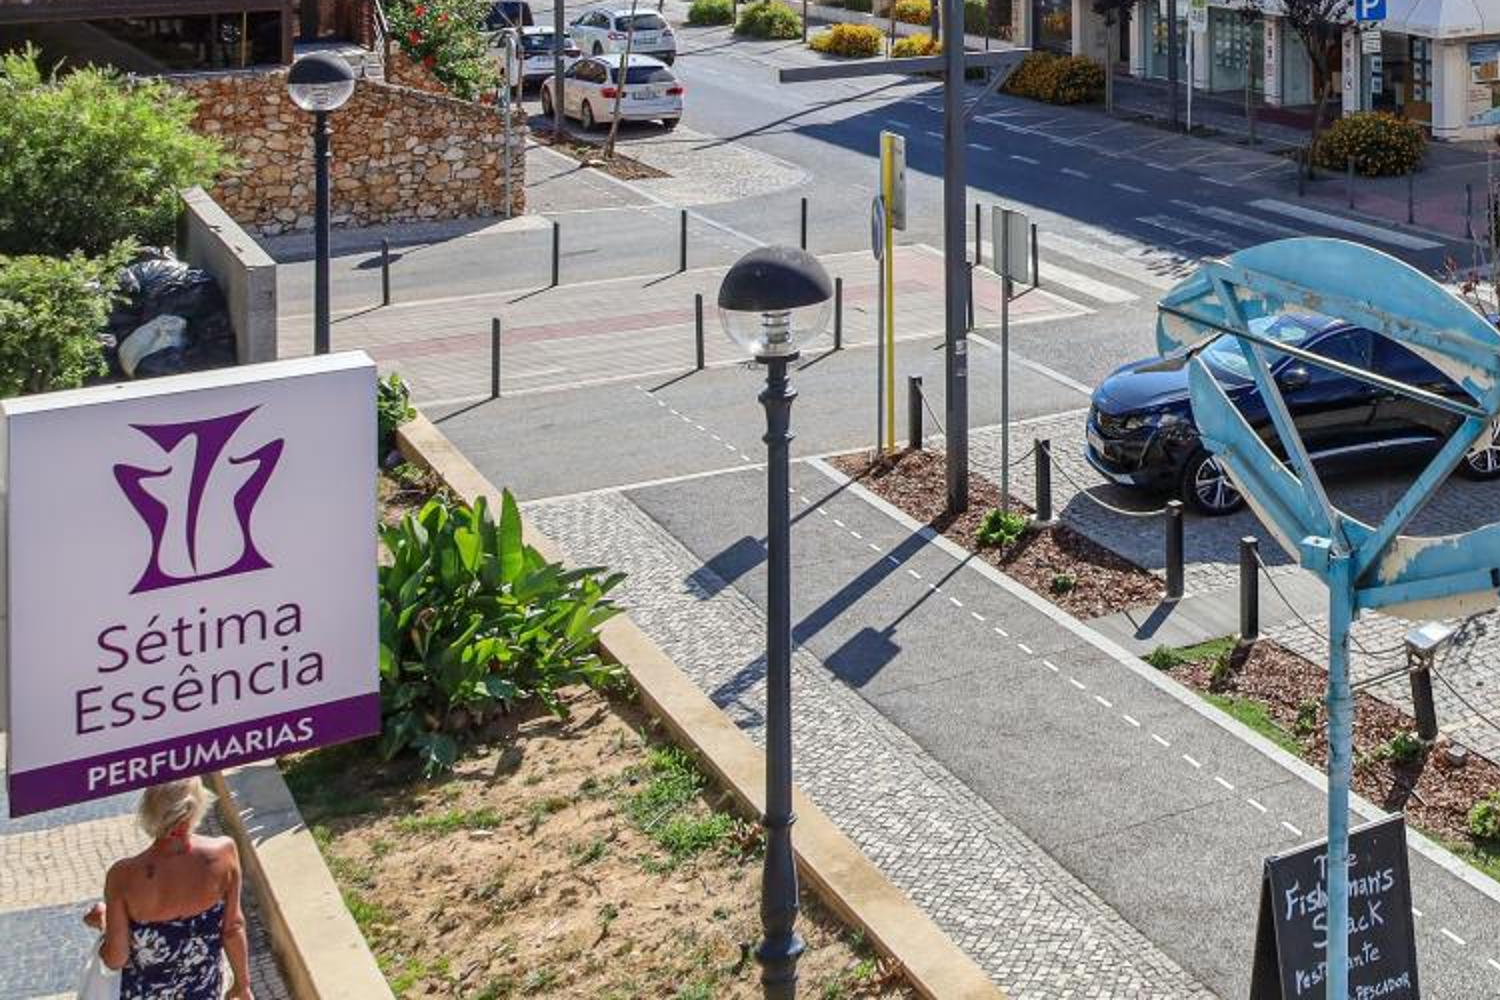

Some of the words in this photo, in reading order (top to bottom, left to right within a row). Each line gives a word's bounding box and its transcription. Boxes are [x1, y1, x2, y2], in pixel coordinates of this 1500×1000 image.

[97, 602, 302, 674] Sétima
[76, 645, 324, 736] Essência
[88, 717, 314, 791] PERFUMARIAS
[1313, 853, 1358, 879] Te
